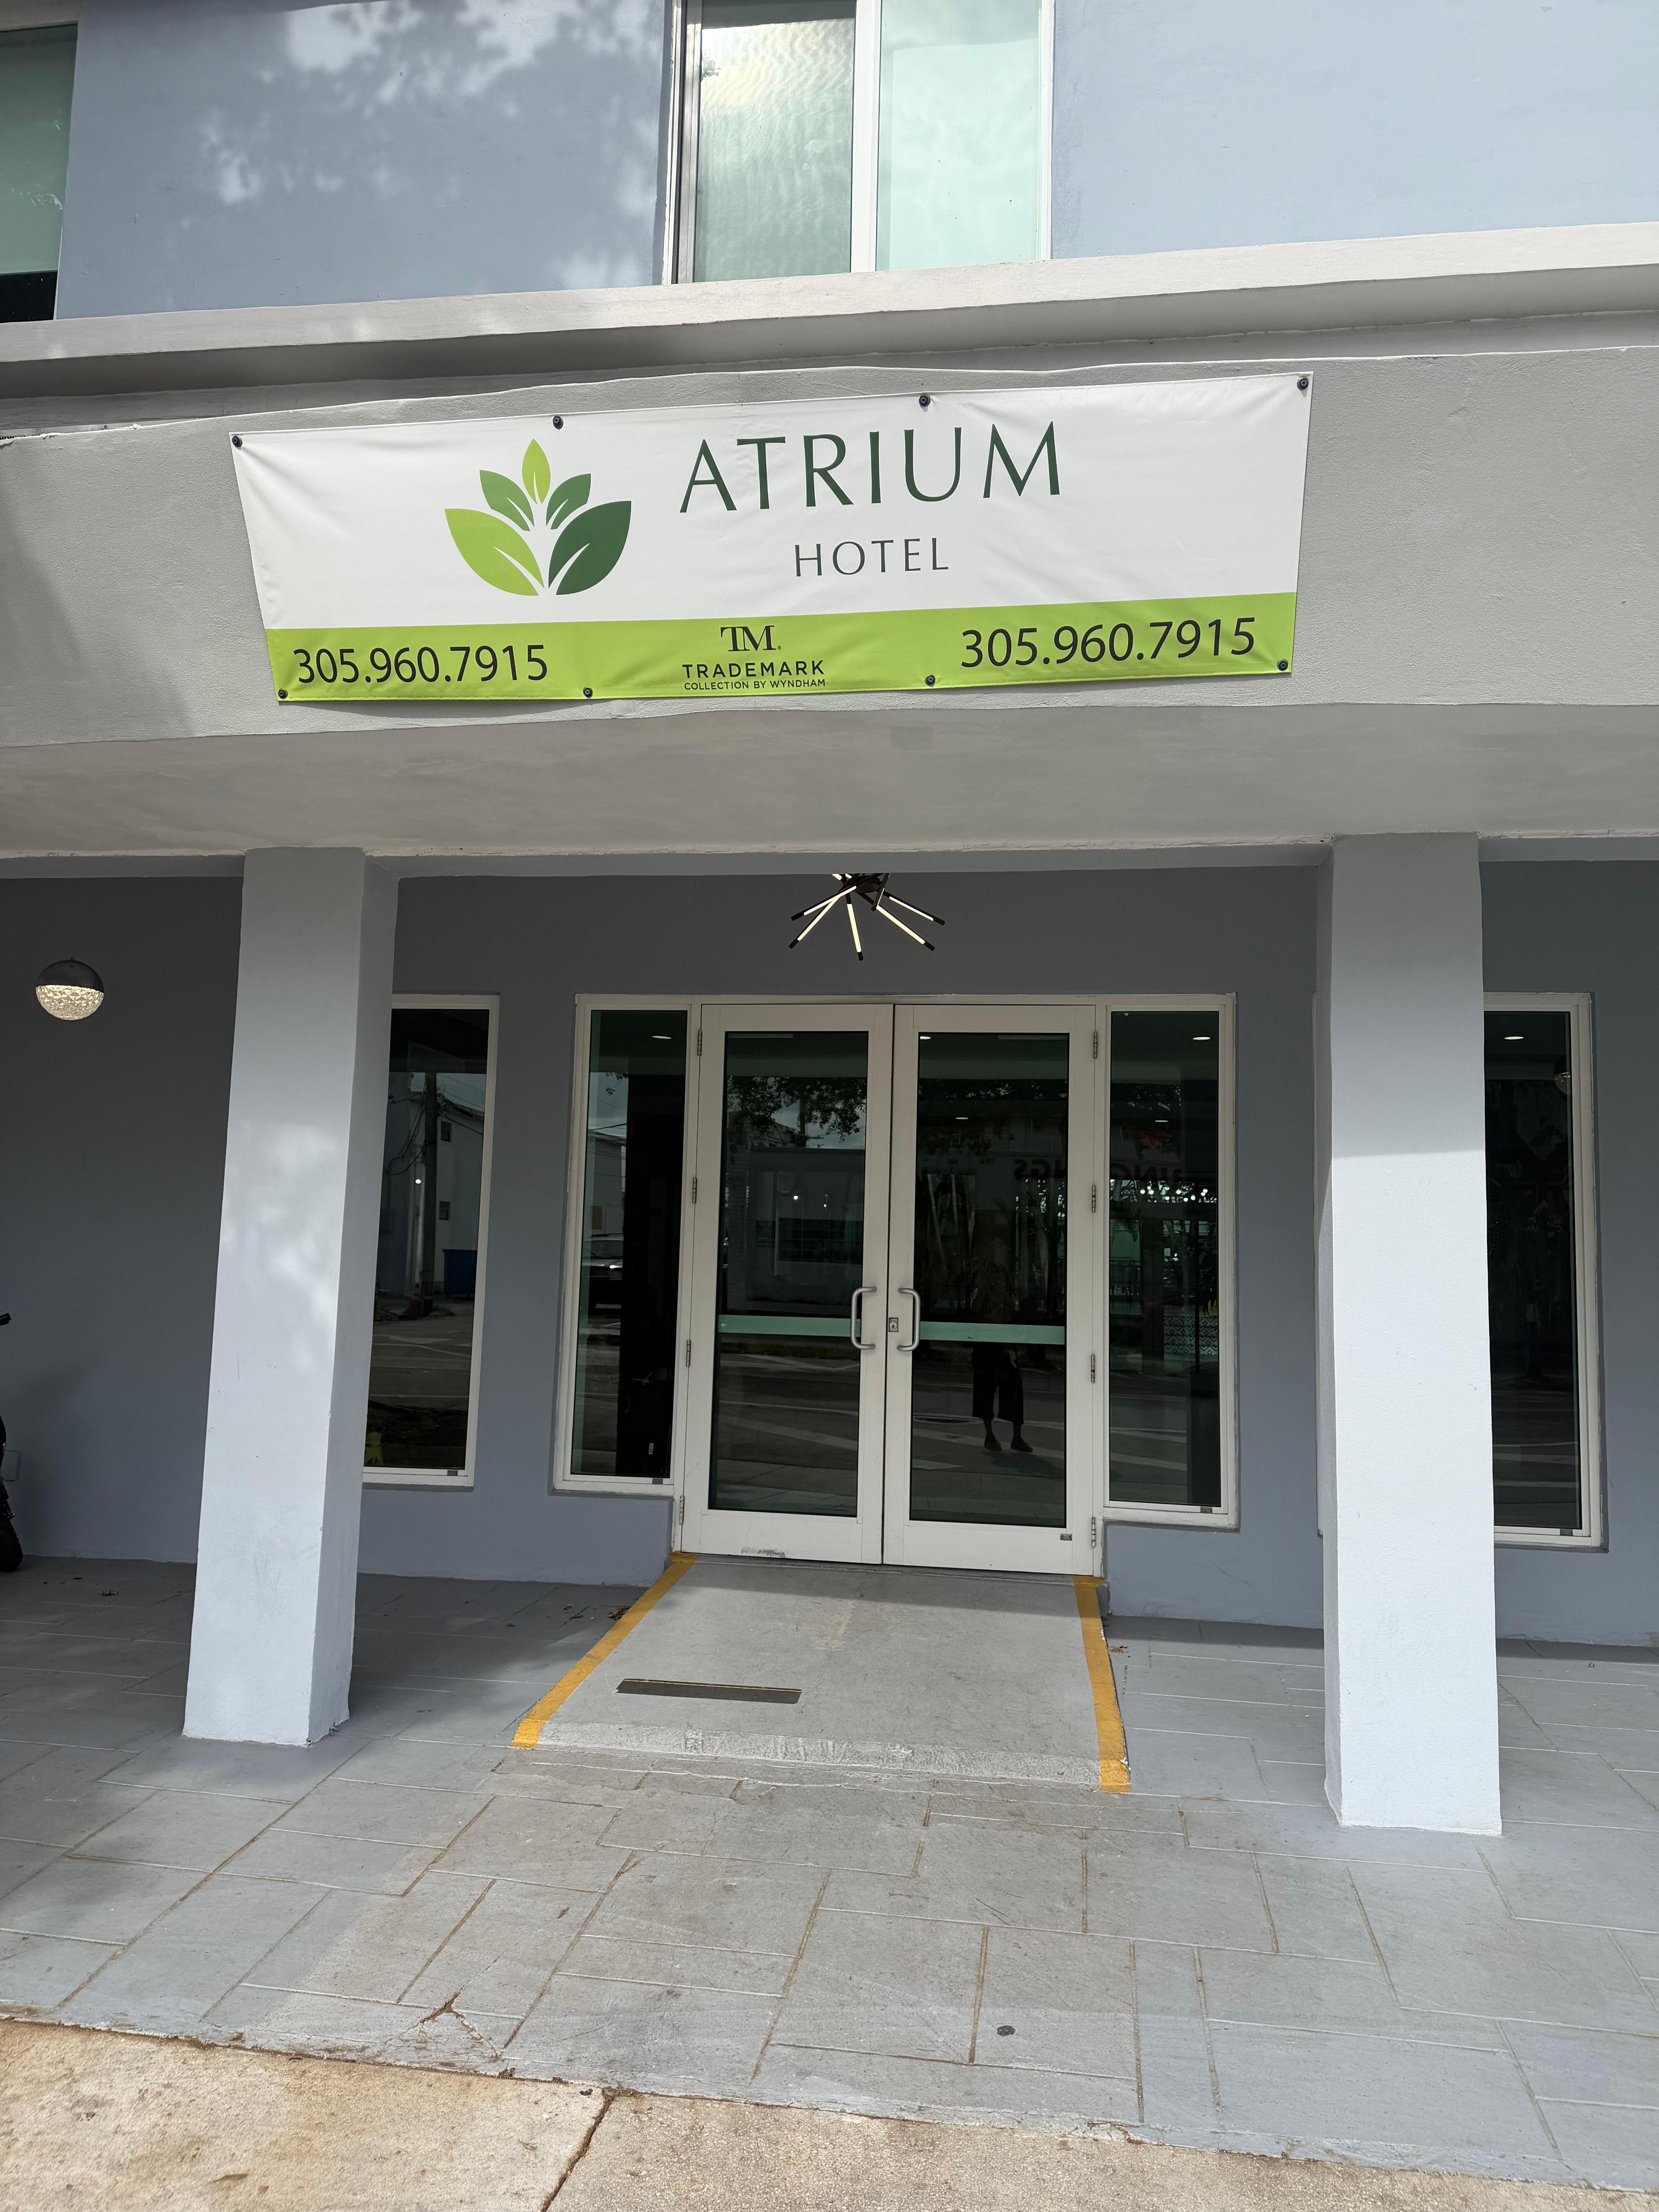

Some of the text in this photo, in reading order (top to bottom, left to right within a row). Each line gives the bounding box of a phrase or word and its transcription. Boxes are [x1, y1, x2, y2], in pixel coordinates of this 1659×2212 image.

[679, 421, 1060, 513] ATRIUM
[795, 538, 948, 577] HOTEL
[961, 617, 1255, 668] 305.960.7915
[293, 644, 547, 684] 305.960.7915
[682, 660, 824, 678] TRADEMARK
[684, 678, 825, 690] COLLECTION BY WYNDHAM
